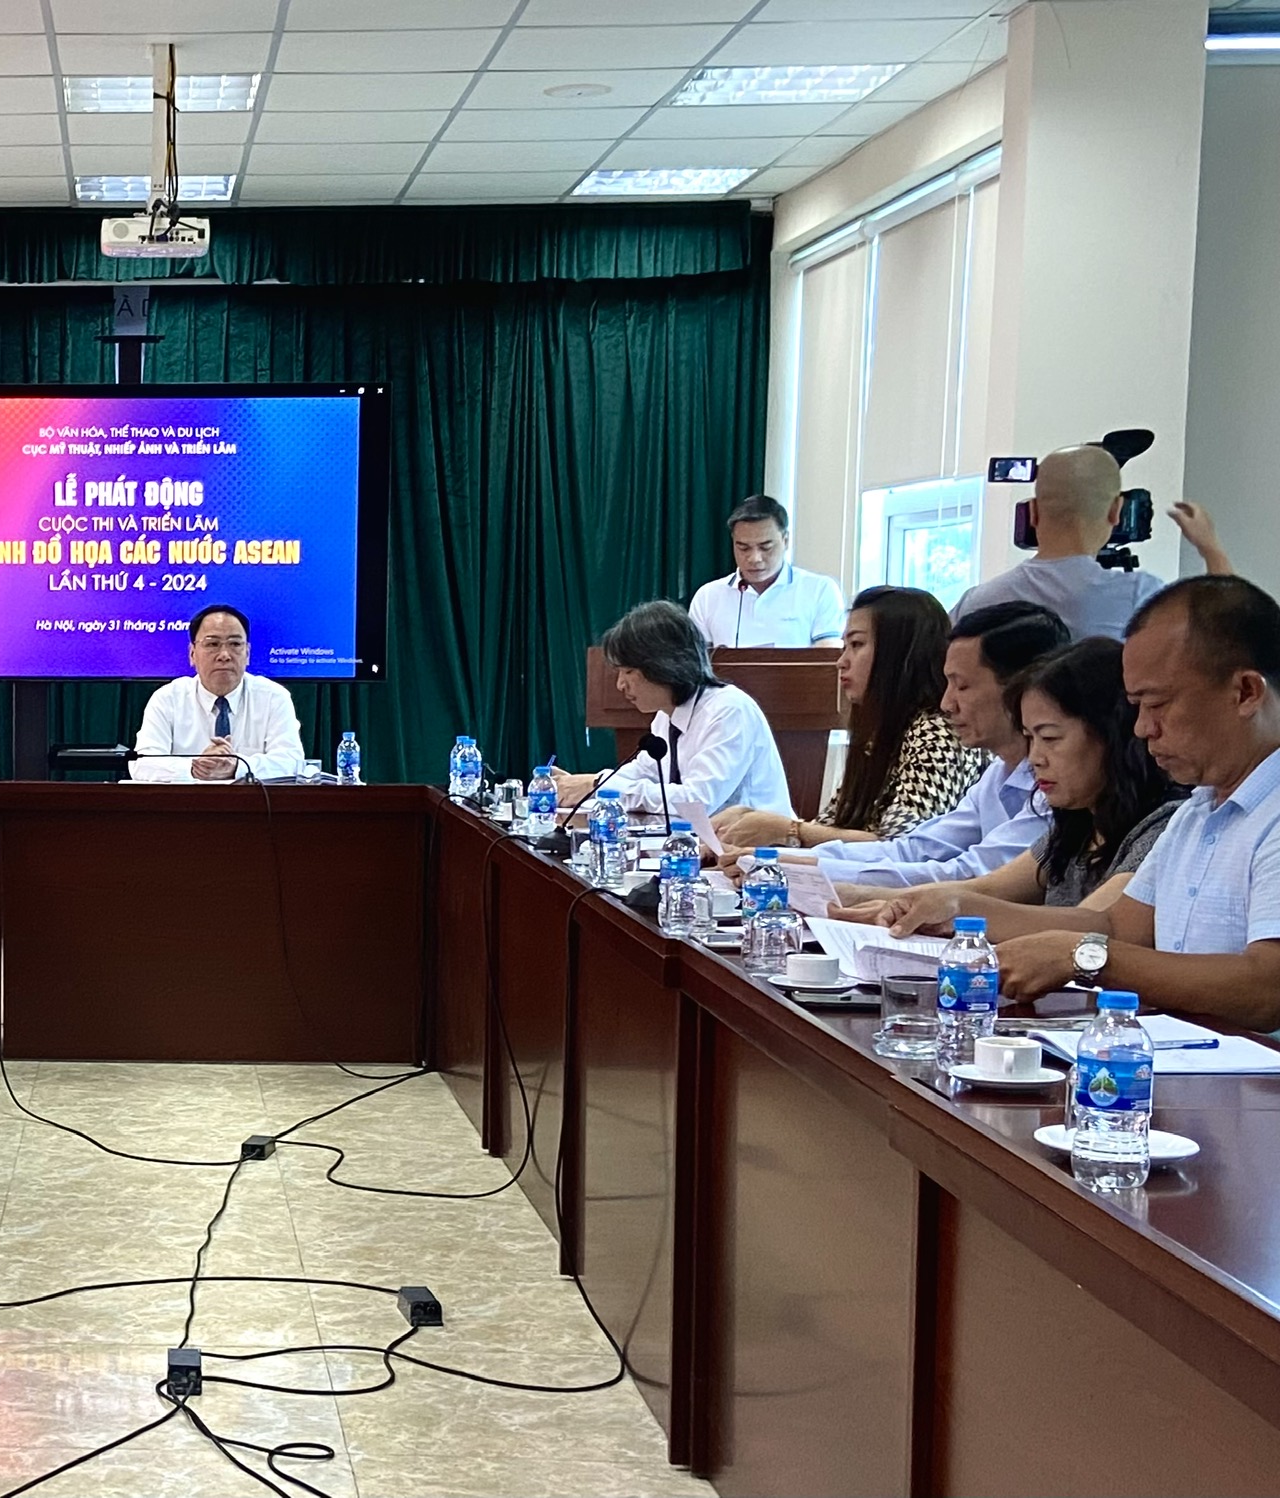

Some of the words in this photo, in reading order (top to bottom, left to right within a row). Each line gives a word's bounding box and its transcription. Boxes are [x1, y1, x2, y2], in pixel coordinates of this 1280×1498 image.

[39, 426, 55, 440] BỘ
[56, 426, 79, 438] VĂN
[80, 426, 108, 439] HÓA,
[130, 427, 160, 438] THAO
[161, 425, 176, 438] VÀ
[177, 427, 193, 438] DU
[195, 427, 220, 440] LỊCH
[22, 444, 47, 457] CỤC
[49, 441, 66, 455] MỸ
[67, 441, 102, 457] THUẬT,
[103, 440, 136, 455] NHIẾP
[137, 440, 162, 455] ẢNH
[164, 441, 180, 455] VÀ
[213, 441, 237, 455] LÃM
[54, 472, 78, 507] LỄ
[84, 474, 138, 507] PHÁT
[143, 476, 205, 510] ĐỘNG
[38, 514, 88, 534] CUỘC
[91, 516, 114, 532] THI
[117, 513, 138, 532] VÀ
[141, 511, 182, 532] TRIỂN
[186, 514, 219, 532] LÃM
[31, 532, 62, 565] ĐỒ
[70, 539, 113, 569] HỌA
[119, 533, 161, 565] CÁC
[168, 533, 227, 565] NƯỚC
[233, 539, 301, 565] ASEAN
[48, 568, 88, 591] LẦN
[91, 571, 130, 591] THỨ
[132, 574, 145, 591] 4
[161, 573, 208, 591] 2024
[35, 620, 52, 631] Hà
[54, 620, 75, 632] Nội,
[77, 620, 107, 633] ngày
[108, 620, 120, 631] 31
[123, 620, 156, 633] tháng
[157, 620, 166, 631] 5
[269, 647, 299, 656] Activate
[300, 647, 335, 656] Windows
